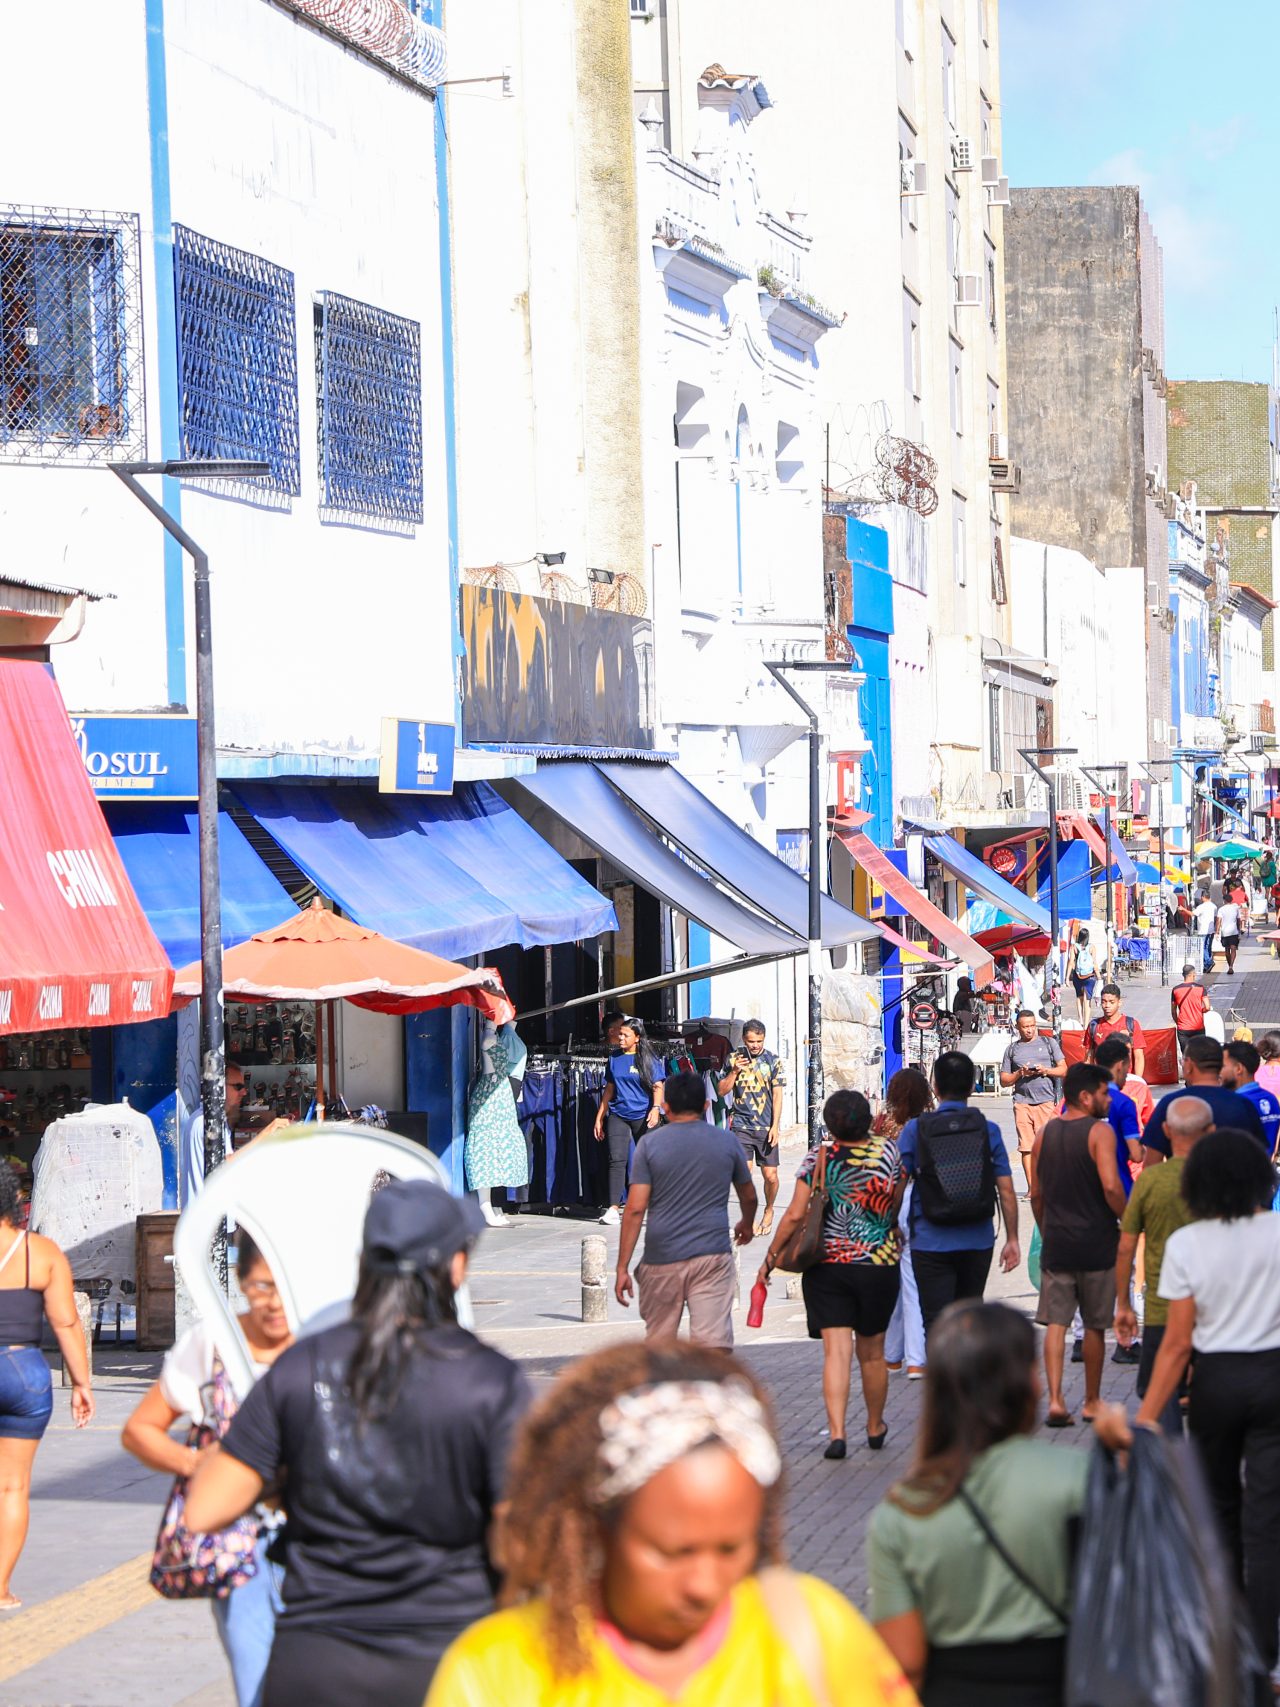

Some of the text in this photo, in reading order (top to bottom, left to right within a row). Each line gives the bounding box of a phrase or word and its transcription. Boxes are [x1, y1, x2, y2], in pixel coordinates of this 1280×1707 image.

[91, 778, 137, 787] RIME
[46, 848, 117, 909] CHINA
[39, 985, 63, 1020] CHINA
[88, 983, 110, 1016] CHINA
